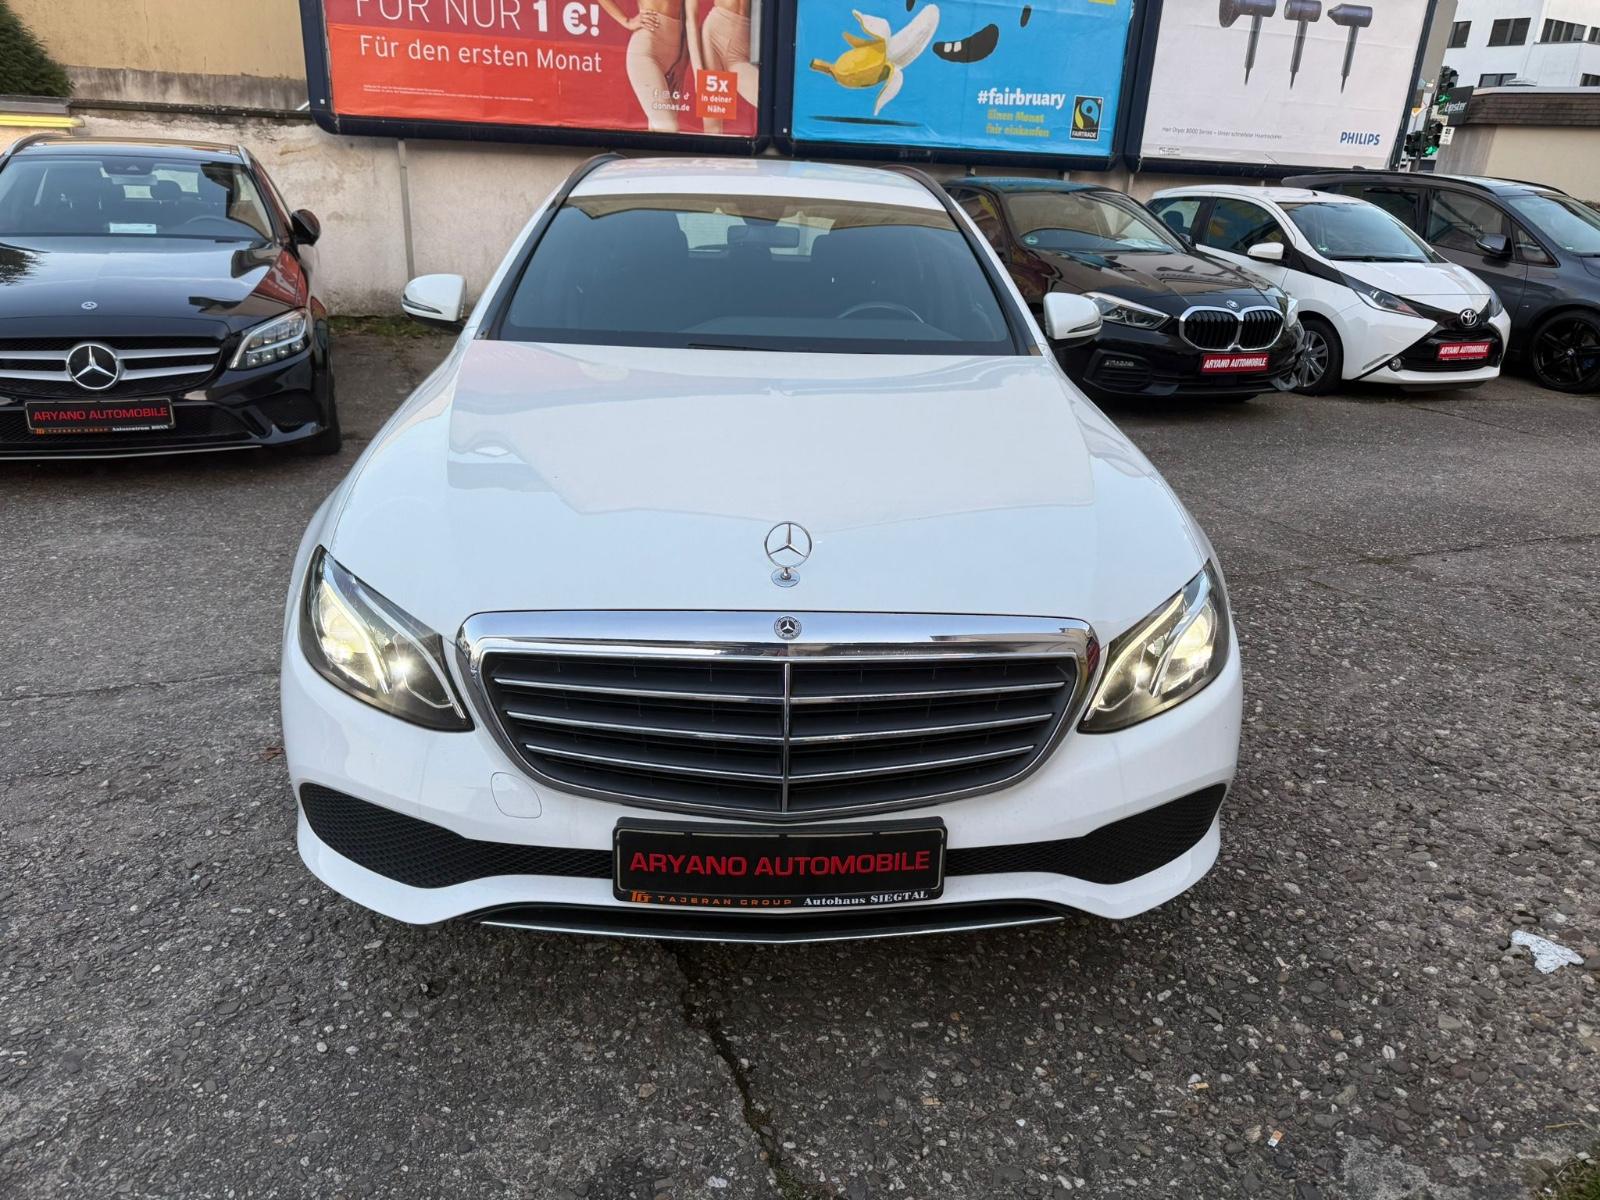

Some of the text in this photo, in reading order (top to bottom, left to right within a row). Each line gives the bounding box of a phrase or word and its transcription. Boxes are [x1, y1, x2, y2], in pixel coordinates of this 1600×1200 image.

[445, 0, 521, 30] NUR
[533, 0, 548, 33] 1
[360, 35, 602, 73] Für den ersten Monat
[706, 75, 729, 93] 5x
[709, 94, 732, 103] deiner
[977, 88, 1066, 109] #fairbruary
[707, 105, 726, 114] Nähe
[1071, 130, 1097, 138] FAIRTRADE
[1340, 131, 1381, 145] PHILIPS
[1203, 357, 1268, 368] ARYANO AUTOMOBILE
[33, 407, 168, 421] ARYANO AUTOMOBILE
[629, 850, 931, 877] ARYANO AUTOMOBILE
[803, 896, 866, 906] Autohaus
[870, 890, 929, 904] SIEGTAL
